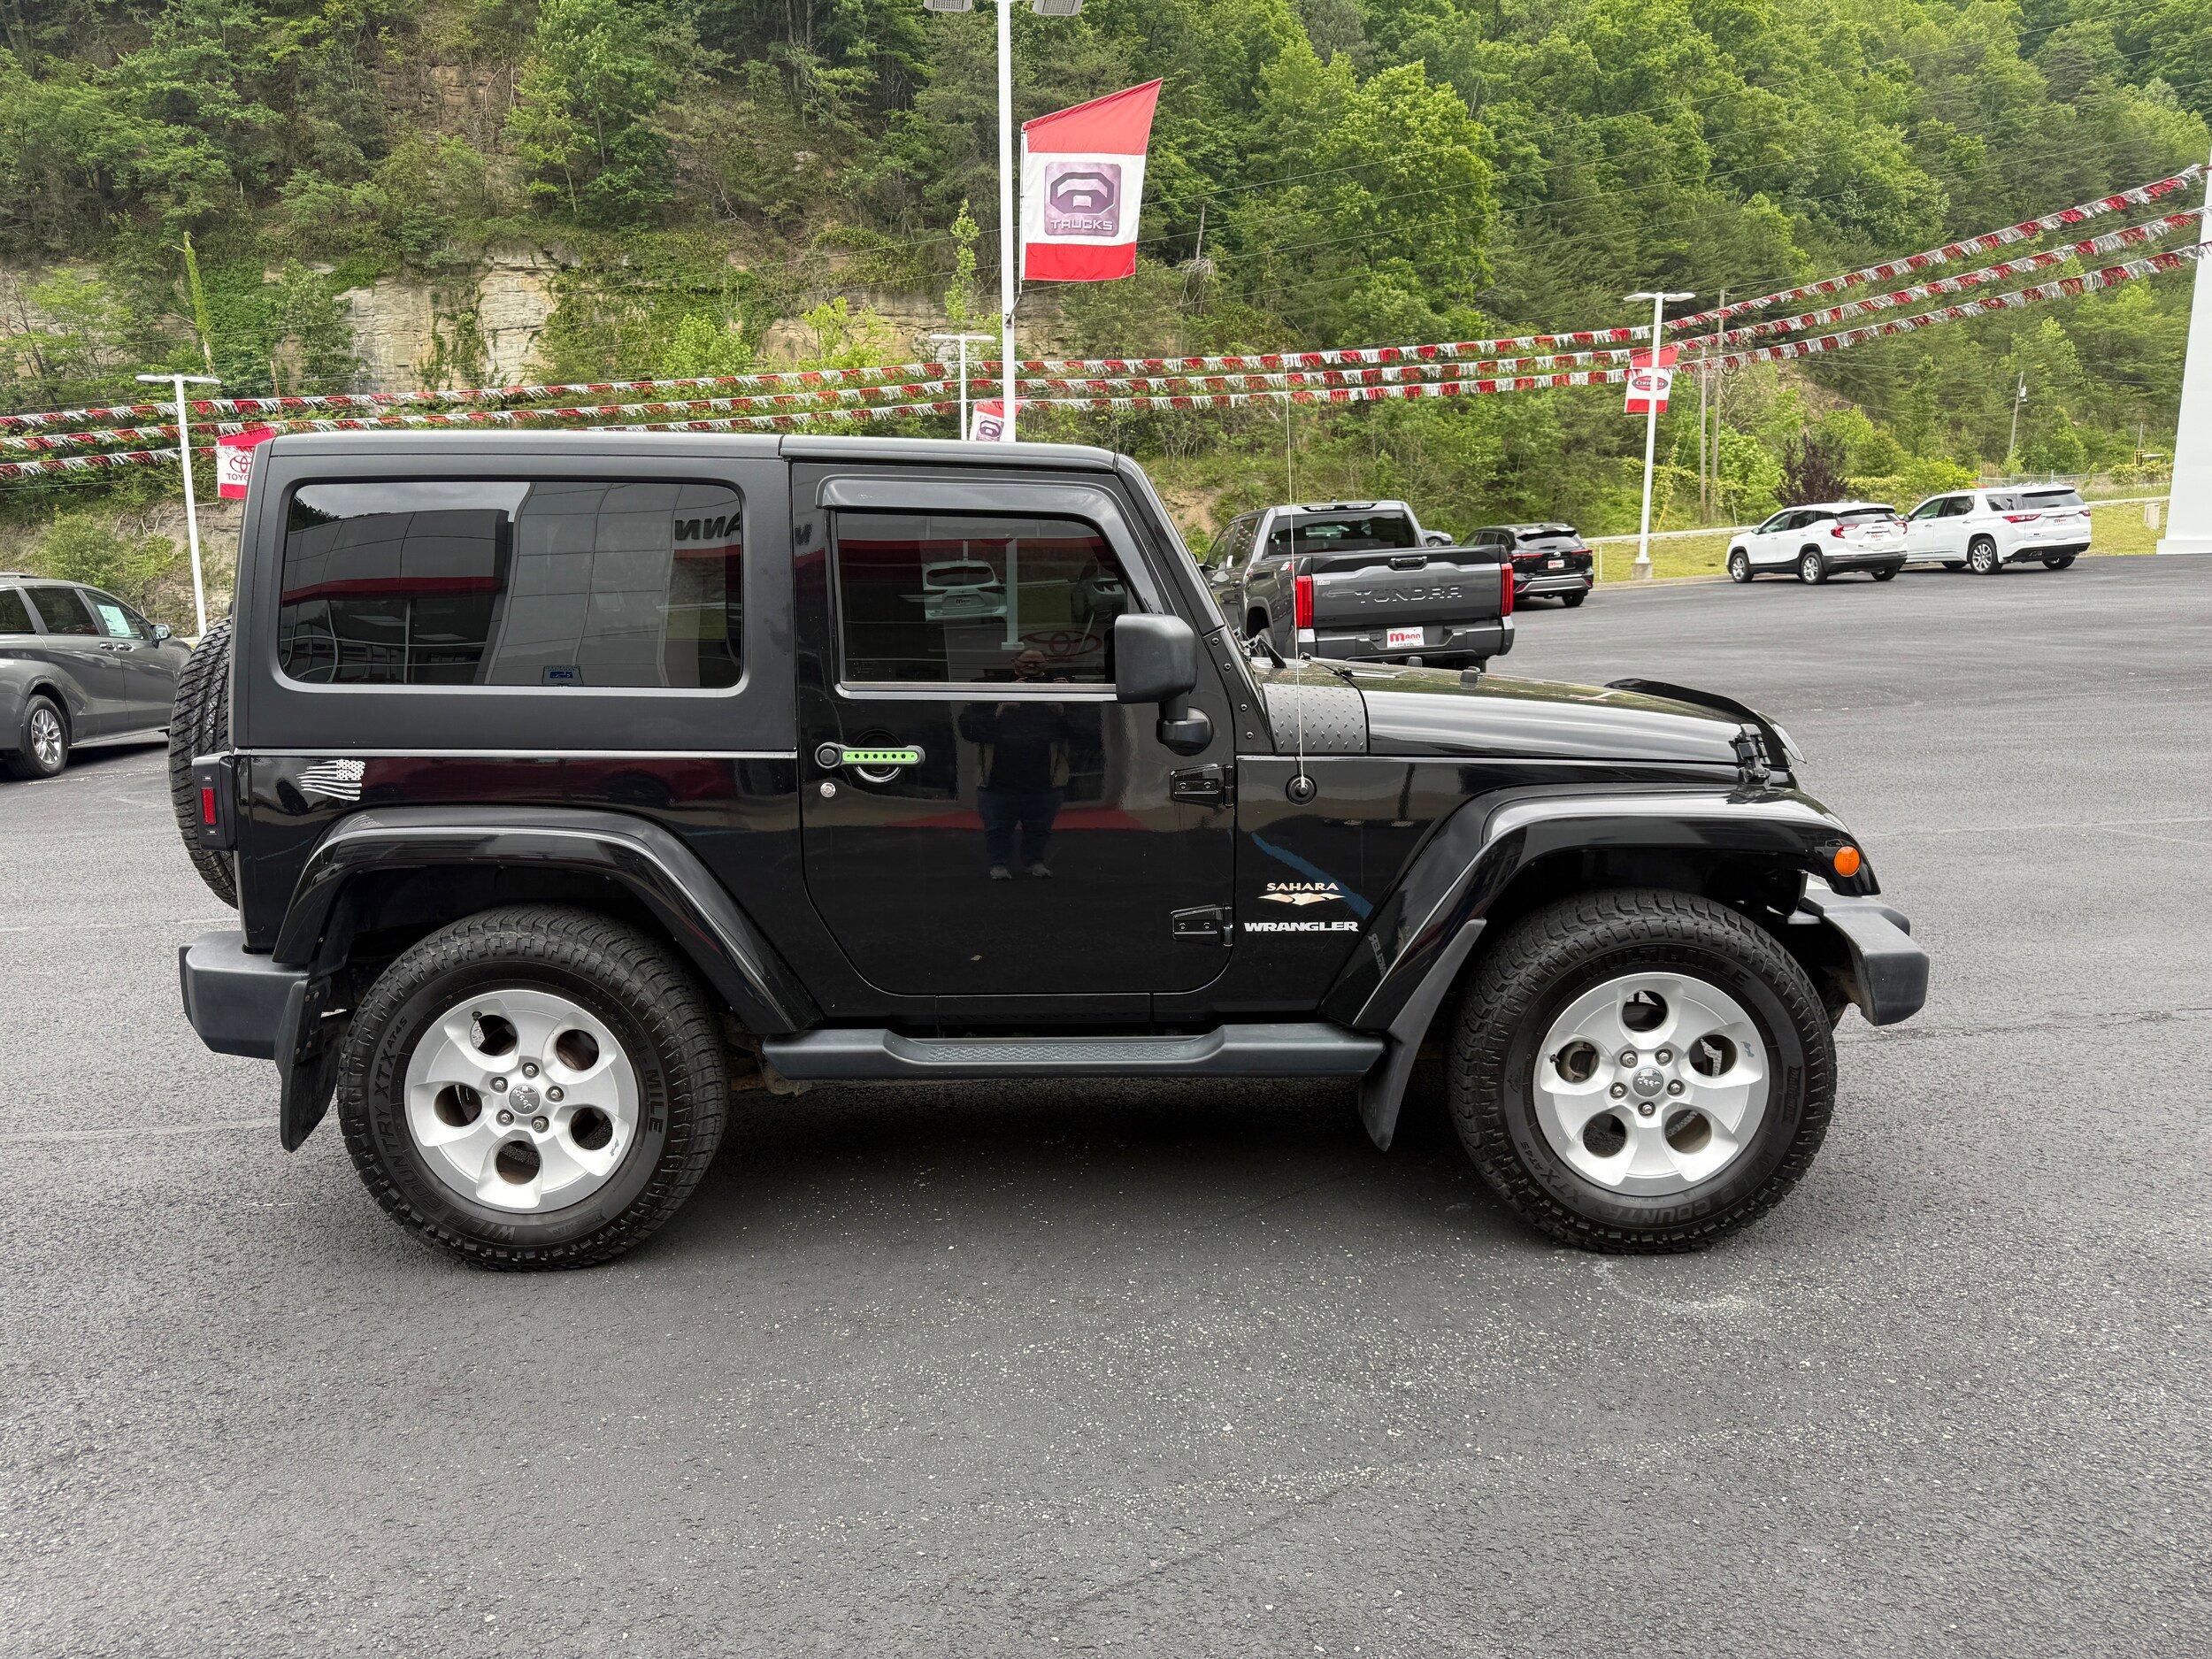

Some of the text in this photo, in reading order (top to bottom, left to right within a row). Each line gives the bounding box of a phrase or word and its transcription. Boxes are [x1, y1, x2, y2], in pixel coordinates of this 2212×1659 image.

[1050, 219, 1113, 231] TRUCKS
[227, 472, 248, 481] TOYO
[1355, 585, 1463, 603] TUNDRA
[1266, 882, 1340, 892] SAHARA
[1244, 921, 1359, 932] WRANGLER
